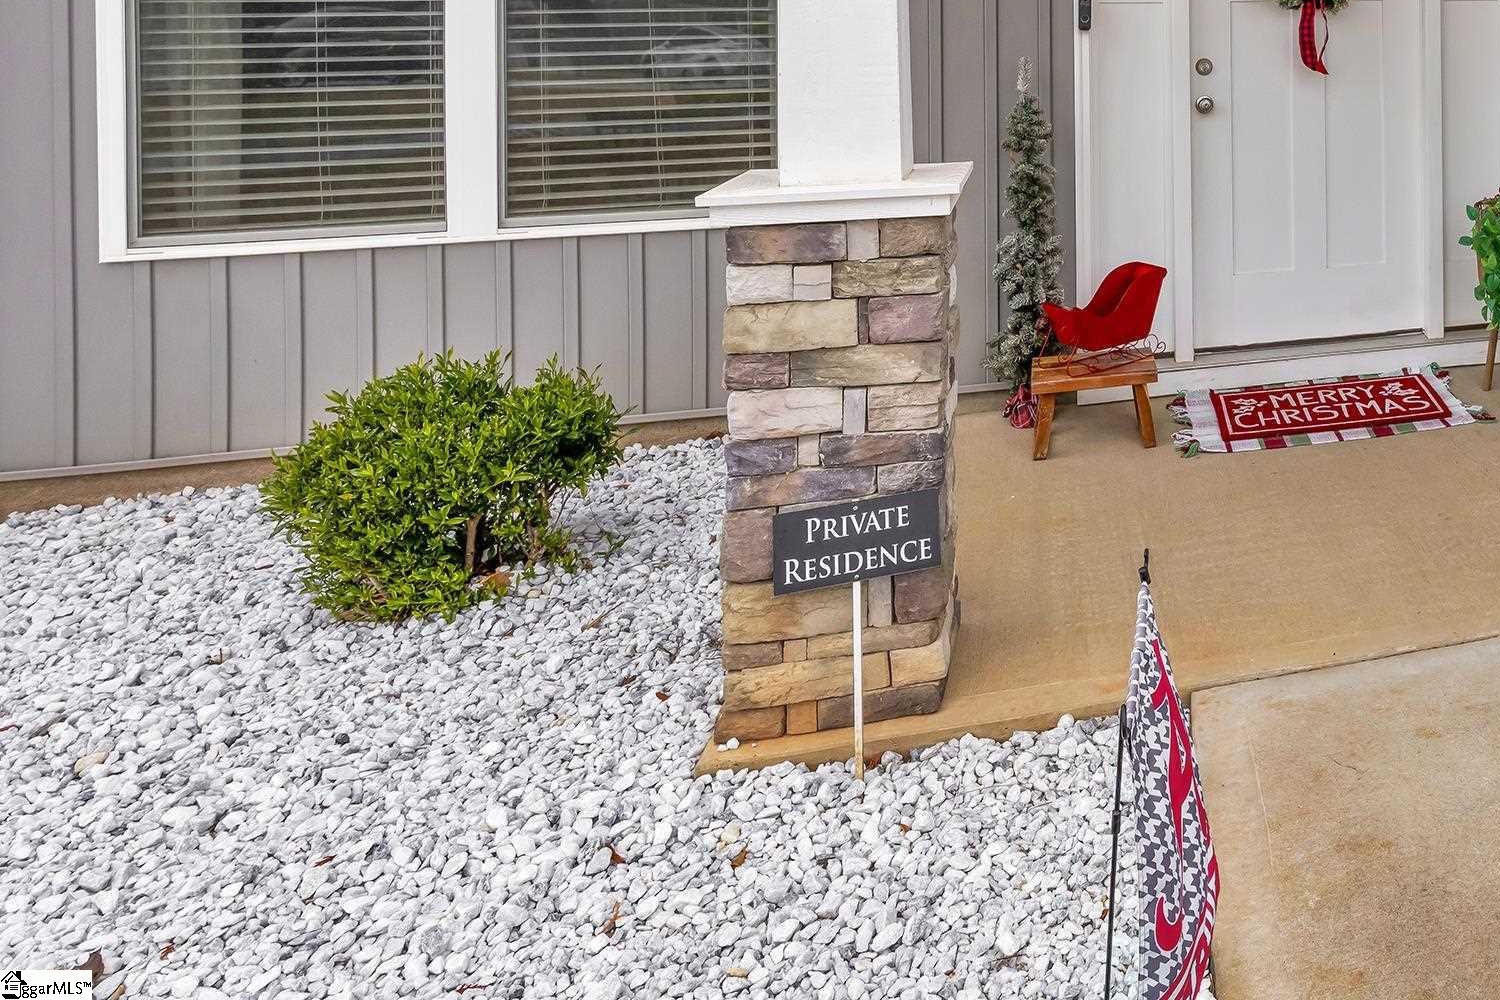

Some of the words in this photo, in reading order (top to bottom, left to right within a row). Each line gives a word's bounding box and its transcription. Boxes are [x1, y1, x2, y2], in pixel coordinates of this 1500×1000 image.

[1234, 395, 1431, 430] CHRISTMAS
[1269, 384, 1377, 409] MERRY
[805, 505, 910, 544] PRIVATE
[783, 537, 933, 586] RESIDENCE
